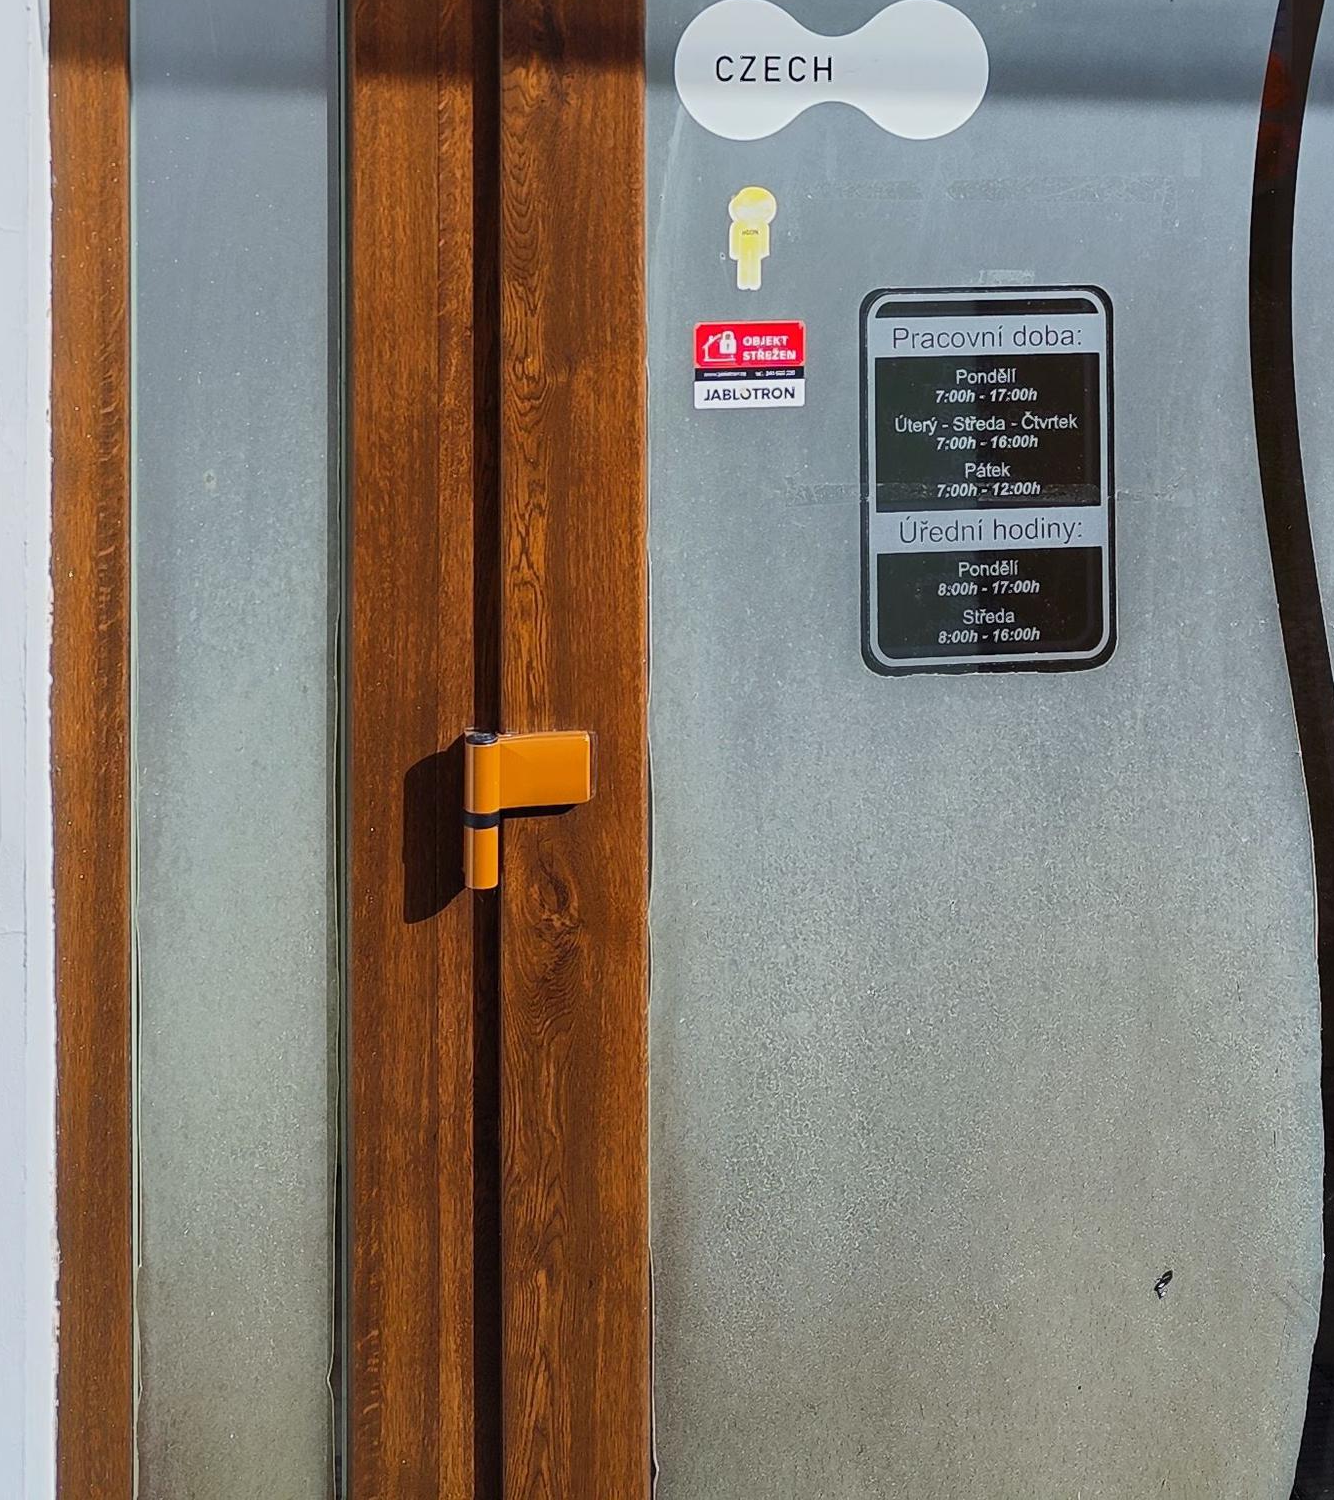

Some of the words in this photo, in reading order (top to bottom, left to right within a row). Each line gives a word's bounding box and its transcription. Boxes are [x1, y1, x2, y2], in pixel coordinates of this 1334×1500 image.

[716, 55, 833, 82] CZECH
[742, 335, 789, 346] OBJEKT
[893, 325, 1003, 349] Pracovní
[1013, 325, 1082, 346] doba:
[742, 348, 796, 361] STŘEŽEN
[956, 368, 1017, 384] Pondělí
[704, 387, 795, 401] JABLOTRON
[936, 390, 975, 403] 7:00h
[990, 388, 1037, 401] 17:00h
[895, 415, 938, 436] Úterý
[953, 416, 1005, 431] Středa
[1021, 411, 1078, 430] Čtvrtek
[936, 436, 976, 450] 7:00h
[990, 435, 1038, 449] 16:00h
[965, 462, 1011, 478] Pátek
[937, 483, 977, 498] 7:00h
[992, 482, 1040, 496] 12:00h
[899, 516, 982, 544] Úřední
[993, 517, 1082, 544] hodiny:
[958, 560, 1018, 577] Pondělí
[938, 582, 977, 596] 8:00h
[992, 580, 1040, 595] 17:00h
[963, 608, 1015, 625] Středa
[938, 630, 978, 645] 8:00h
[992, 628, 1040, 642] 16:00h
